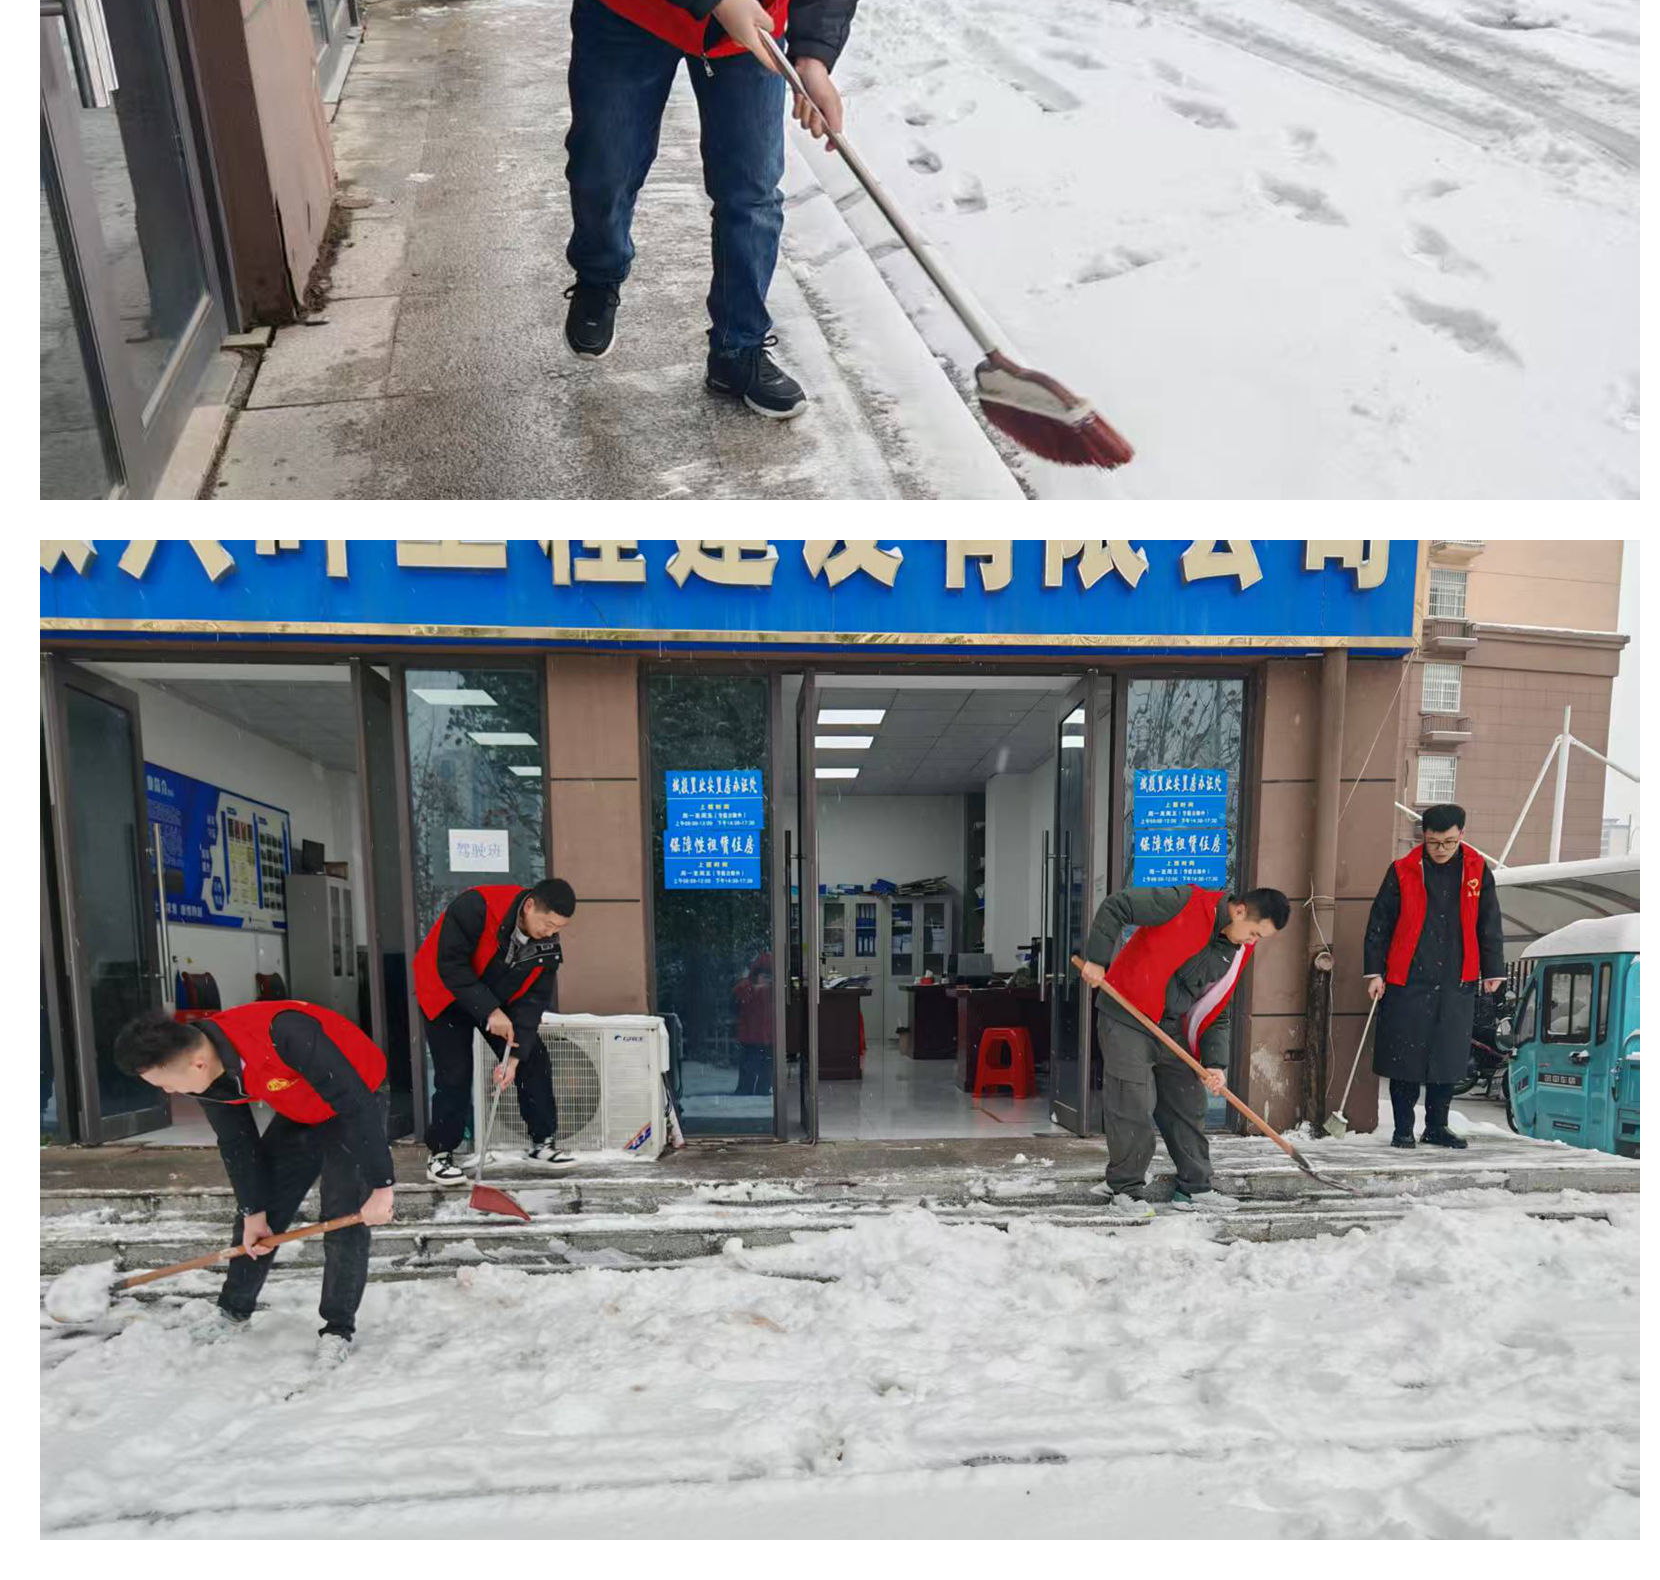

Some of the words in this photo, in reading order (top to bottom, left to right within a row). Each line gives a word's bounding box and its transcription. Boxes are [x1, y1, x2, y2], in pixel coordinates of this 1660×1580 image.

[669, 834, 755, 855] 保障性租赁住房
[1140, 833, 1222, 854] 保障性租赁住房
